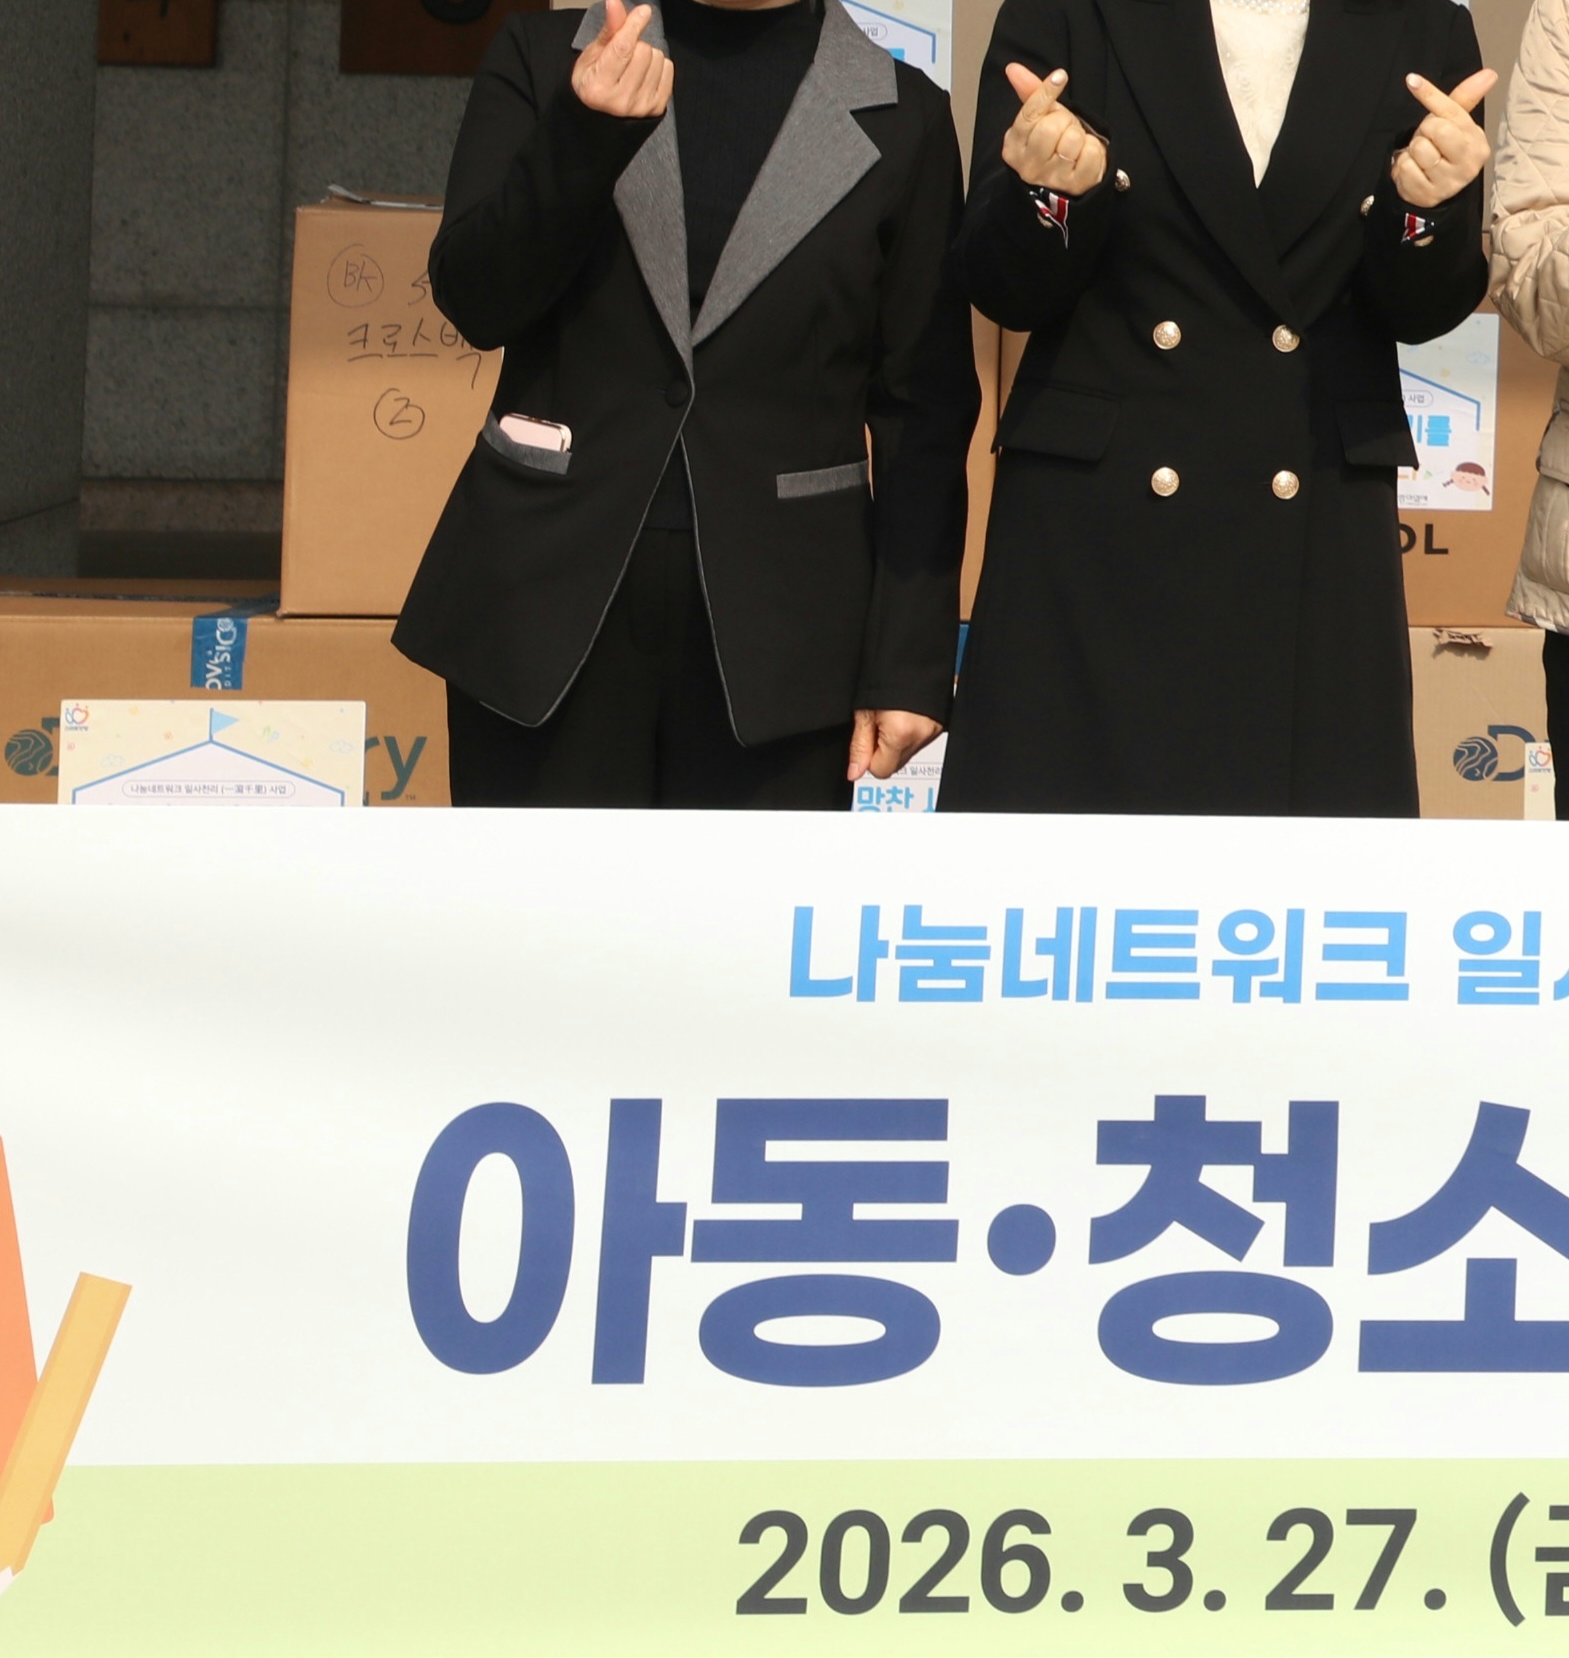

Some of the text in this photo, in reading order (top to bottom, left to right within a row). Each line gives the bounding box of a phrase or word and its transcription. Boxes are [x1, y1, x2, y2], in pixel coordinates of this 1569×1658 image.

[1408, 394, 1425, 404] 사업
[857, 786, 914, 813] 망찬
[790, 904, 1409, 1004] 나눔네트워크
[736, 1509, 1084, 1615] 2026.
[1123, 1508, 1227, 1613] 3.
[1265, 1507, 1446, 1610] 27.
